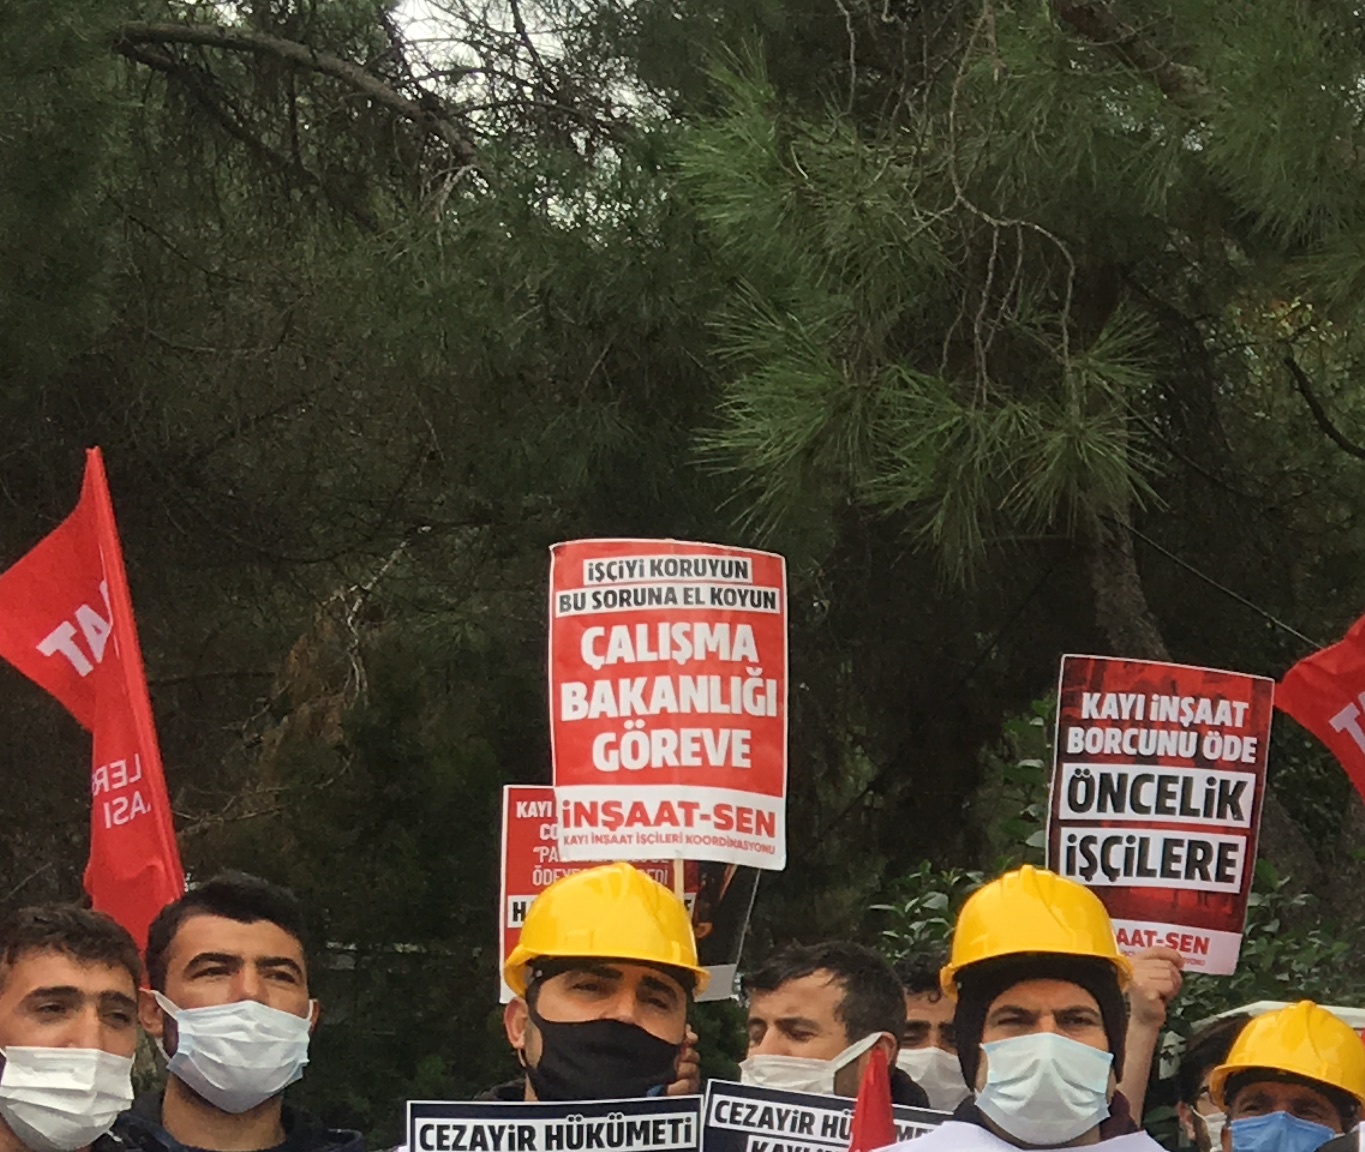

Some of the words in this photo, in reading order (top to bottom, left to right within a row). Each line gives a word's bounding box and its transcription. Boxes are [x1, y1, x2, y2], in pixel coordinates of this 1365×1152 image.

[650, 558, 748, 579] KORUYUN
[559, 592, 586, 613] BU
[592, 587, 677, 610] SORUNA
[683, 588, 705, 605] EL
[710, 588, 776, 609] KOYUN
[581, 622, 759, 670] ÇALIŞMA
[561, 666, 777, 721] BAKANLIĞI
[1081, 692, 1145, 720] KAYI
[593, 719, 751, 771] GÖREVE
[1066, 727, 1199, 758] BORCUNU
[1202, 731, 1258, 764] ÖDE
[1116, 928, 1210, 955] AAT-SEN
